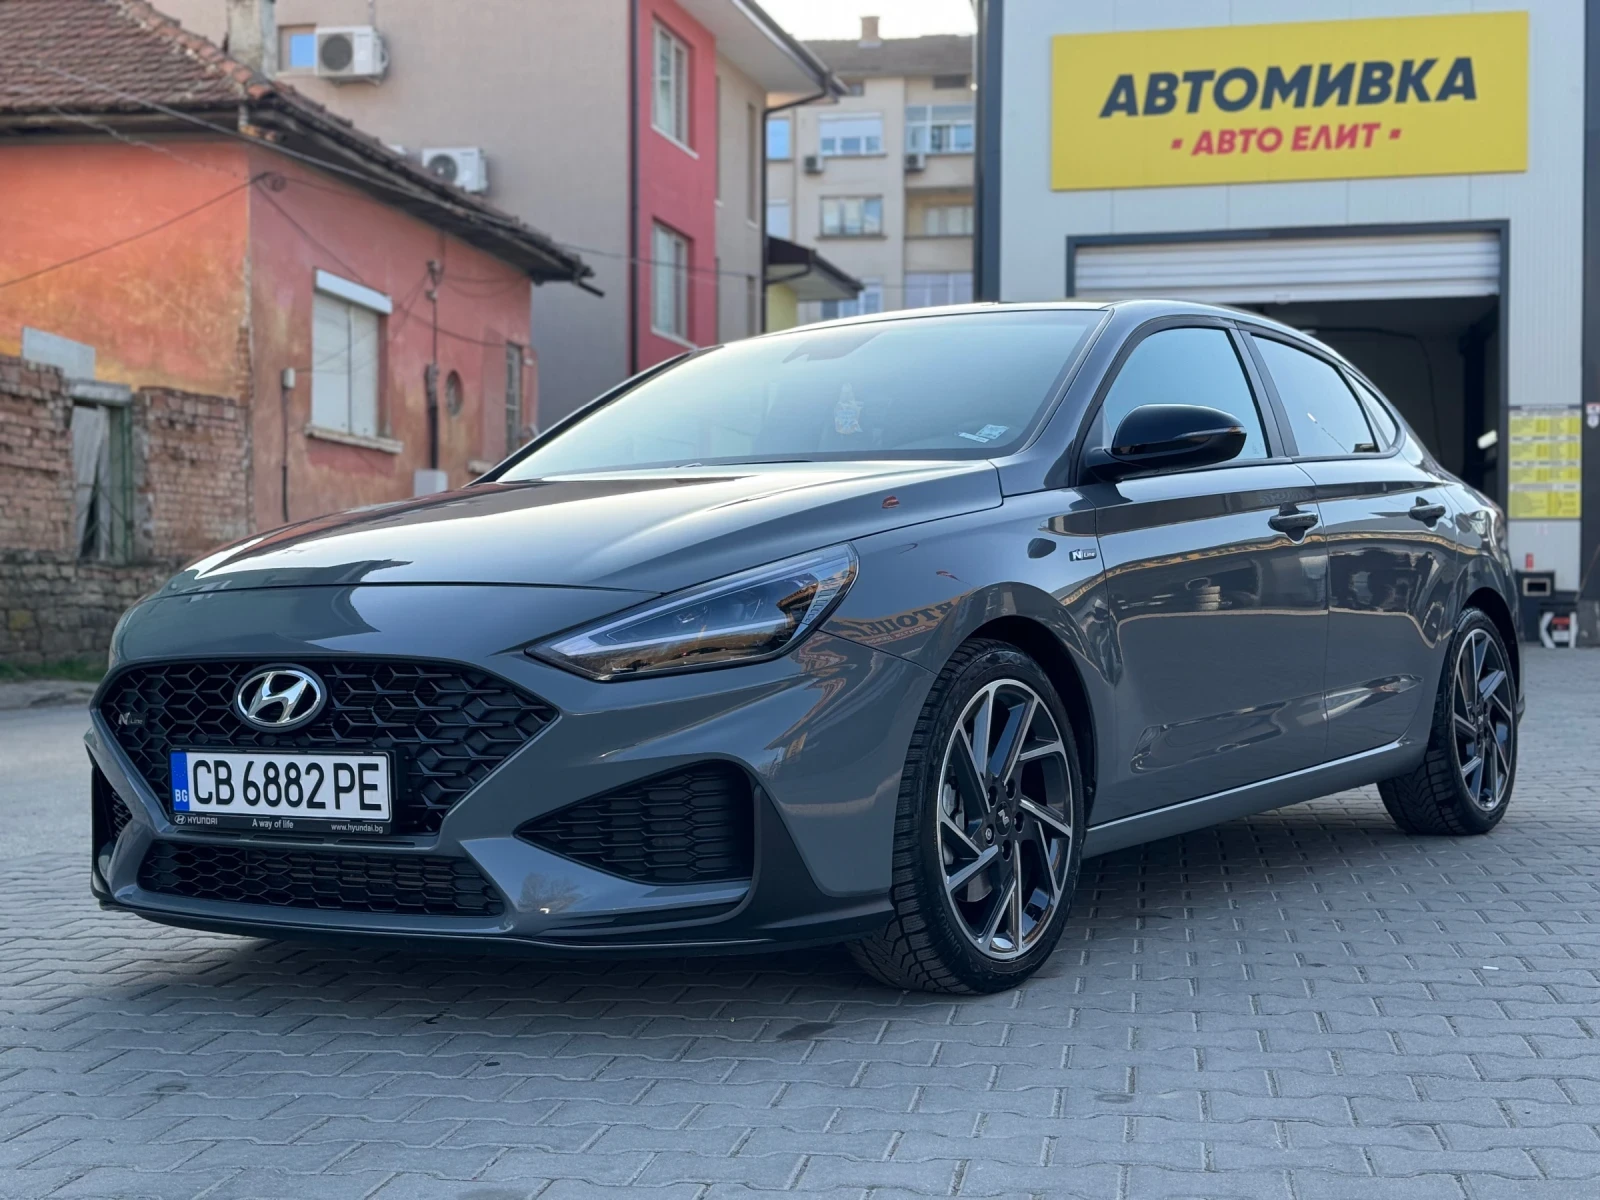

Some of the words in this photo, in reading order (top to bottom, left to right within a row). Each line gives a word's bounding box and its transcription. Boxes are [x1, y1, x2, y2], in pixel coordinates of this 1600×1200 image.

[1099, 57, 1478, 119] АВТОМИВКА
[1190, 126, 1284, 156] АВТО
[1291, 122, 1382, 152] ЕЛИТ
[192, 759, 235, 806] CB
[242, 760, 326, 810] 6882
[333, 762, 382, 811] PE
[174, 789, 188, 803] BG
[187, 816, 218, 825] HYUNDAI
[252, 818, 258, 827] A
[259, 820, 272, 830] way
[274, 819, 282, 828] of
[282, 820, 294, 829] life
[330, 823, 384, 834] www.hyundai.bg
